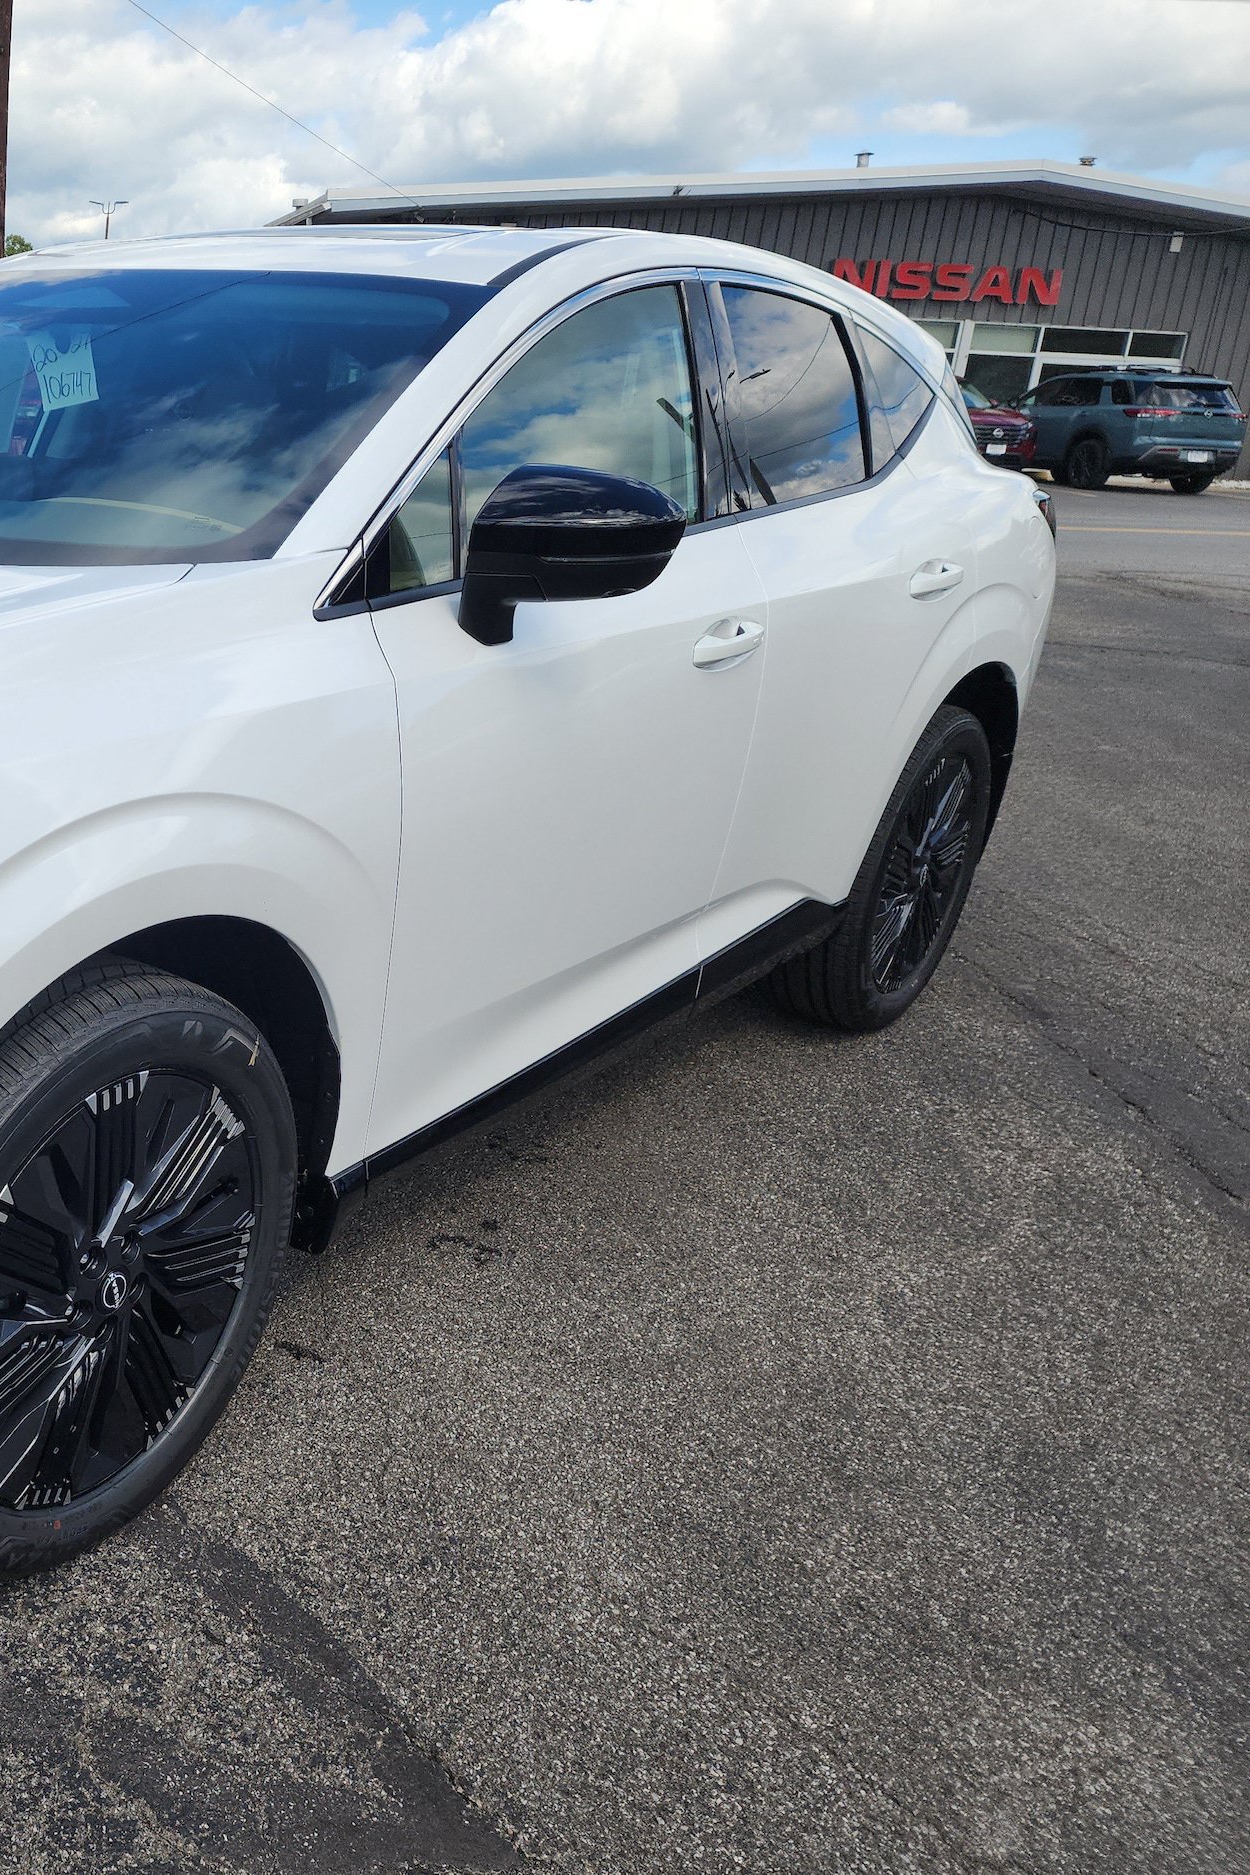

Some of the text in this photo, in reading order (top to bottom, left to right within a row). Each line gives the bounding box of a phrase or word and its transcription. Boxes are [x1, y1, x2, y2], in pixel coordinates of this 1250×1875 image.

[833, 258, 1064, 306] NISSAN
[33, 344, 57, 372] 20
[43, 371, 92, 404] 106747
